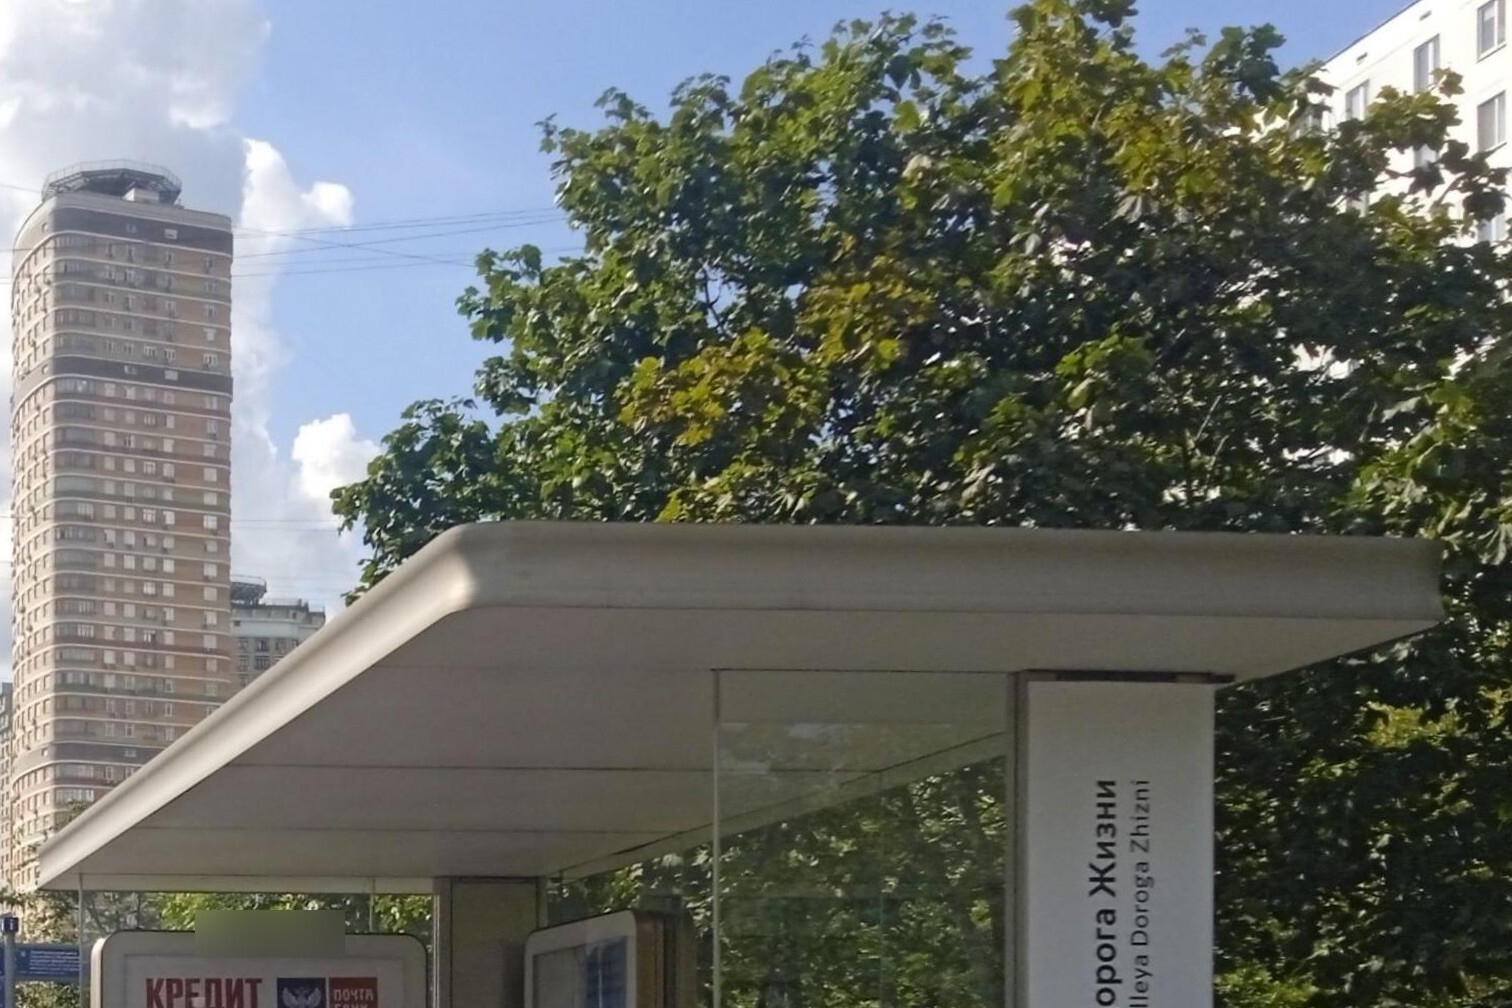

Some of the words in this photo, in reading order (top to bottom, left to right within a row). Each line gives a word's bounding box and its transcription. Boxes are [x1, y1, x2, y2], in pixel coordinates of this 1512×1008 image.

[1088, 779, 1118, 898] Жизни
[1130, 779, 1150, 854] Zhizni
[1130, 860, 1155, 946] Doroga
[333, 987, 376, 1002] ПОЧТА
